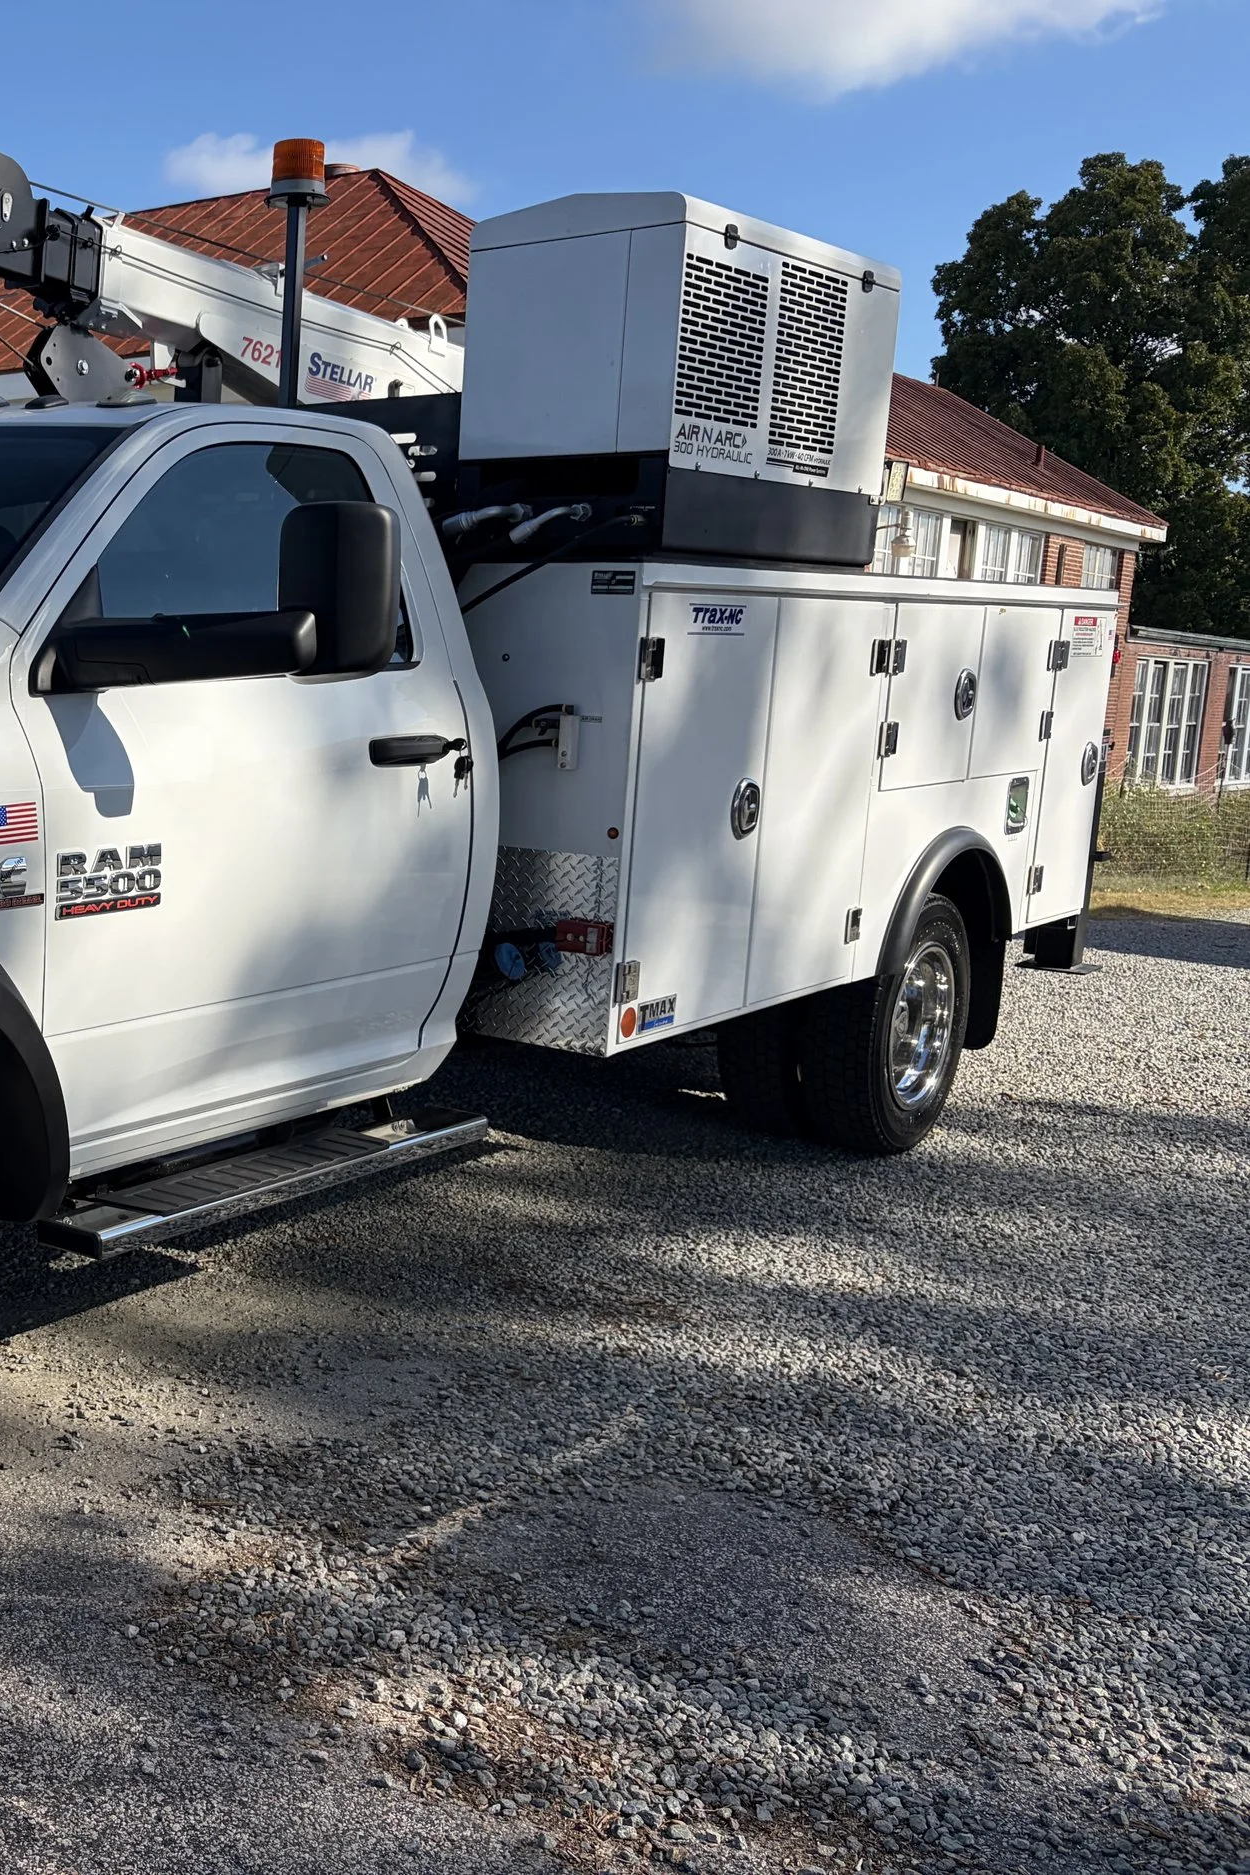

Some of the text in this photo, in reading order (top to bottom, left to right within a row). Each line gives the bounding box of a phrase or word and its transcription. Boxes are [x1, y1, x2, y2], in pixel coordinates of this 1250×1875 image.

[308, 352, 374, 393] STELLAR
[673, 440, 753, 465] 300 HYDRAULIC
[676, 423, 743, 449] AIR N ARC
[57, 843, 161, 877] RAM
[56, 868, 161, 903] 5500
[62, 896, 158, 916] HEAVY DUTY
[640, 997, 676, 1030] TMAX
